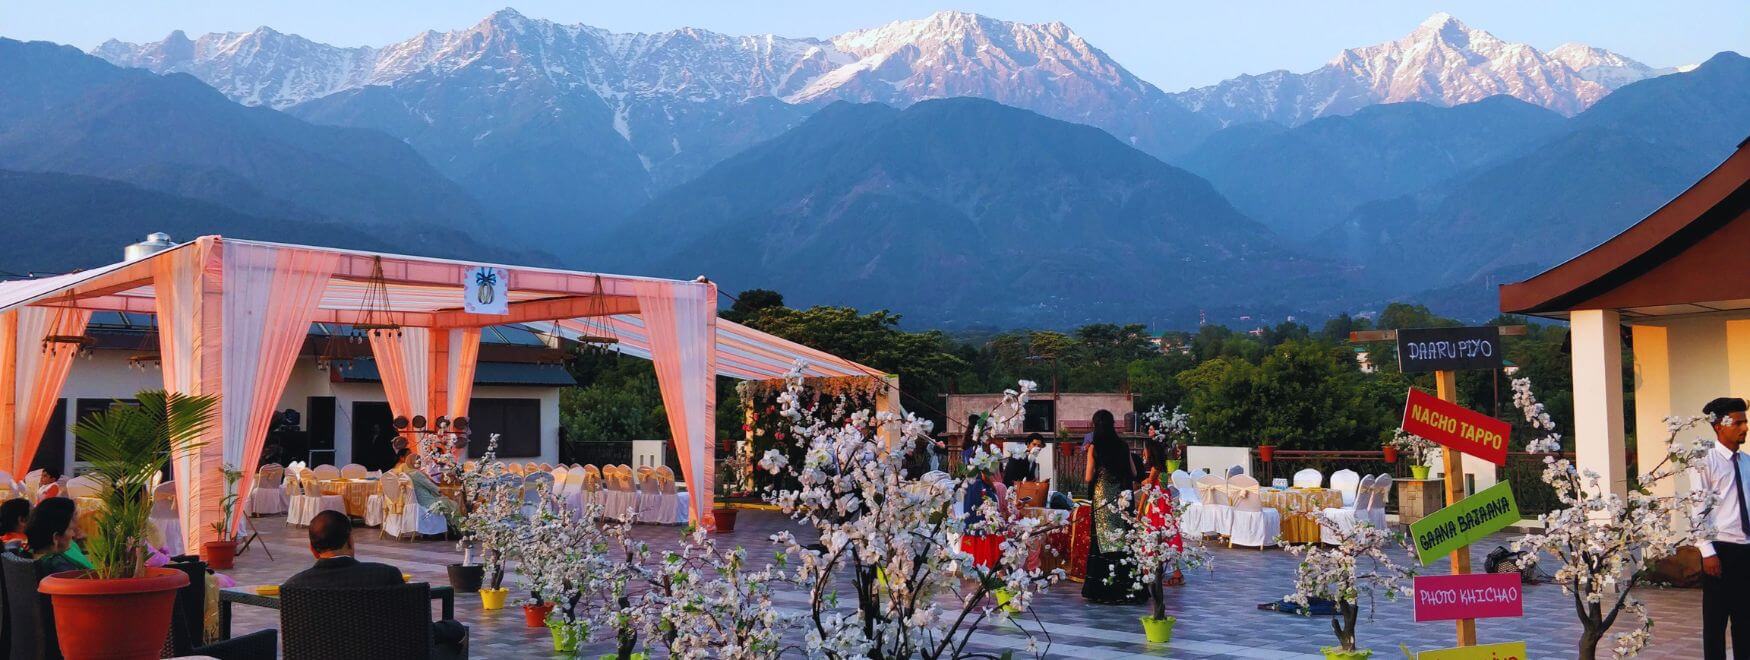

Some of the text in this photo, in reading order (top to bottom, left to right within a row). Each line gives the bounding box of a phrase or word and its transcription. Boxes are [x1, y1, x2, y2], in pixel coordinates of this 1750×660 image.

[1407, 338, 1492, 360] DAARU PIYO
[1411, 403, 1503, 450] NACHO TAPPO
[1420, 496, 1511, 551] GAANA BAJAANA
[1420, 586, 1518, 606] PHOTO KHICHAO
